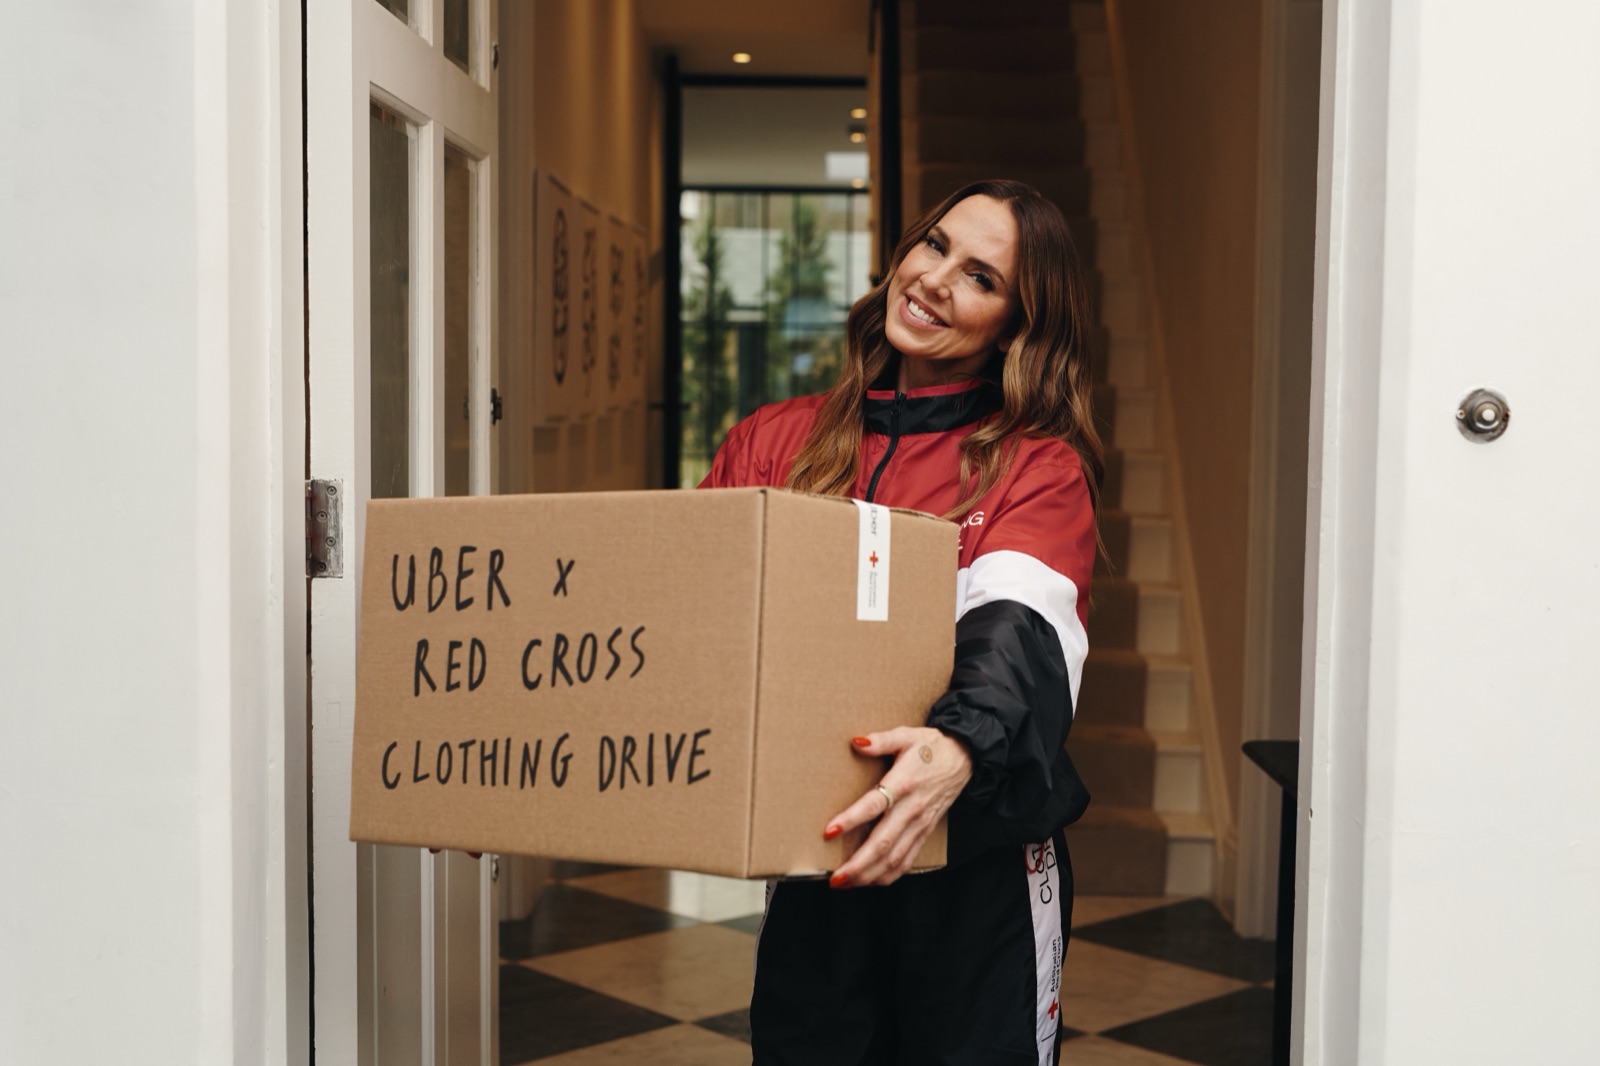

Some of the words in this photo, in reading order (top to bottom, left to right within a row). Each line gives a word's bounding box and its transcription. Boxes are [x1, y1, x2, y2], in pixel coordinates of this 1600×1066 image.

[392, 545, 511, 613] UBER
[414, 637, 487, 697] RED
[521, 626, 646, 691] CROSS
[381, 733, 573, 790] CLOTHING
[599, 729, 711, 792] DRIVE
[1032, 845, 1053, 905] CLOT
